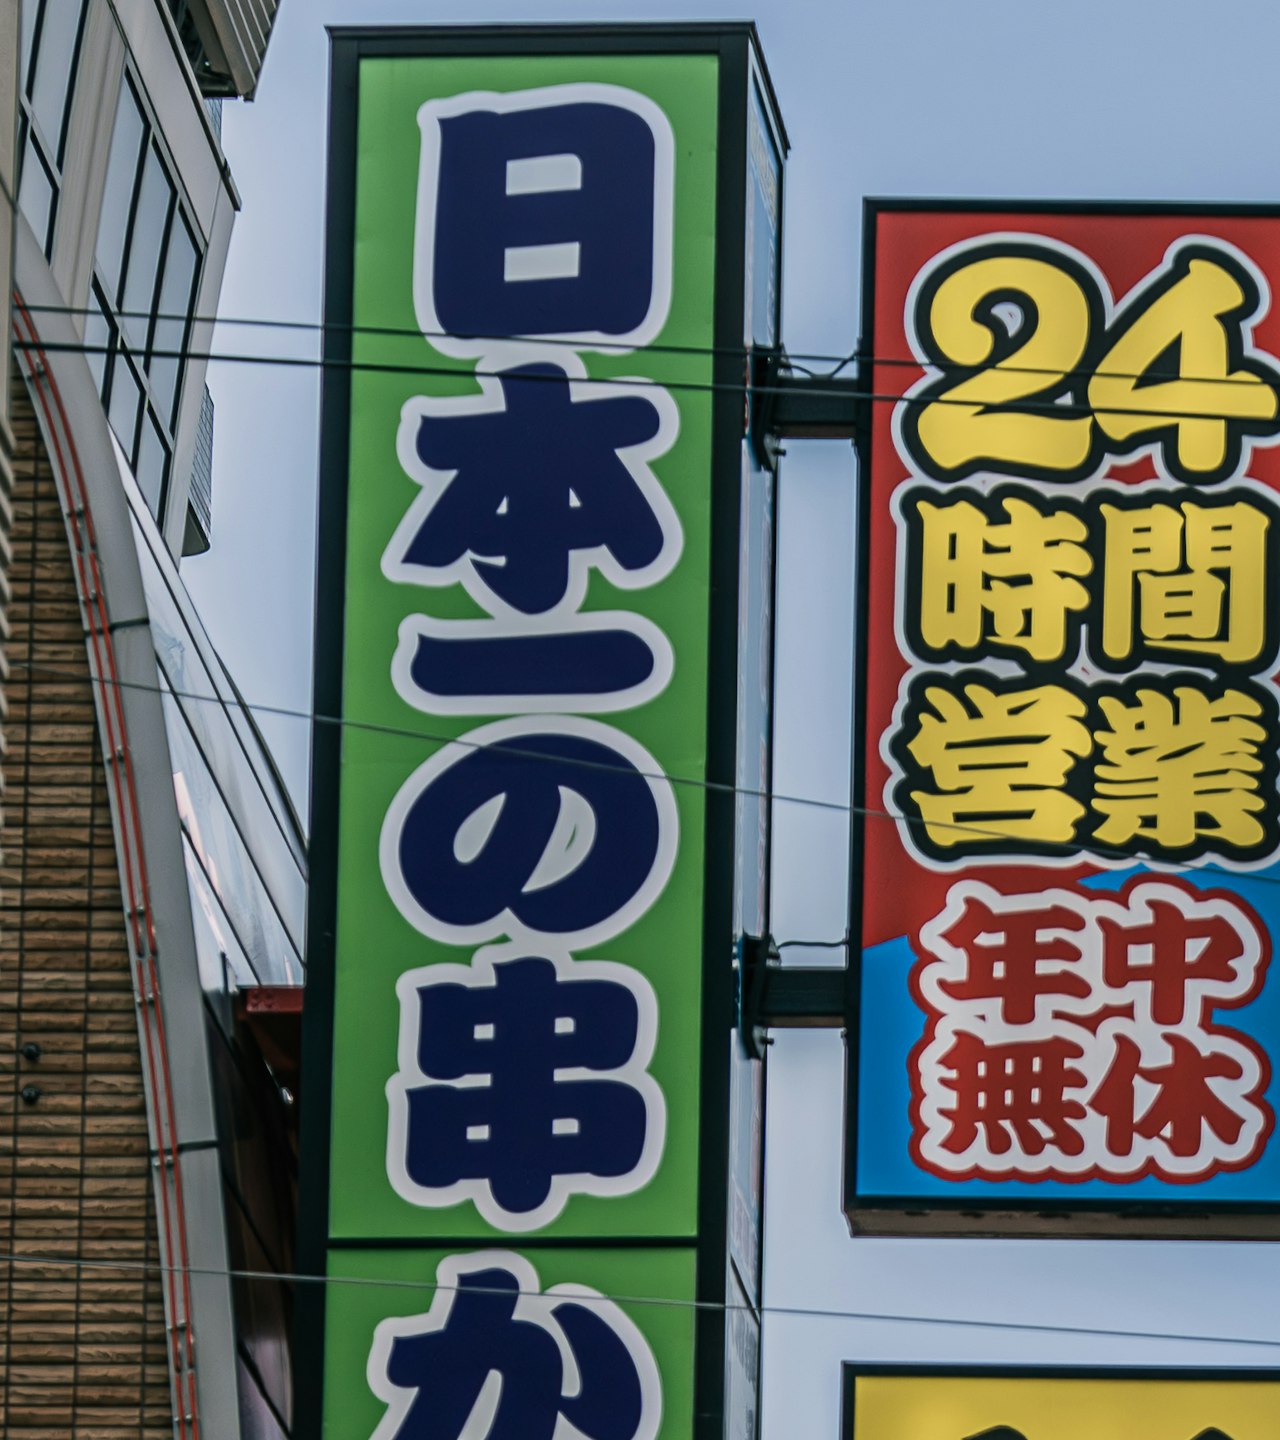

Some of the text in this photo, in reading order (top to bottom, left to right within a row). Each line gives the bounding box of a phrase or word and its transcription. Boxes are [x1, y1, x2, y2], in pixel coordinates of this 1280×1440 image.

[908, 490, 1280, 670] 時間
[902, 680, 1272, 856] 営業
[936, 890, 1254, 1030] 年中
[934, 1028, 1248, 1162] 無休
